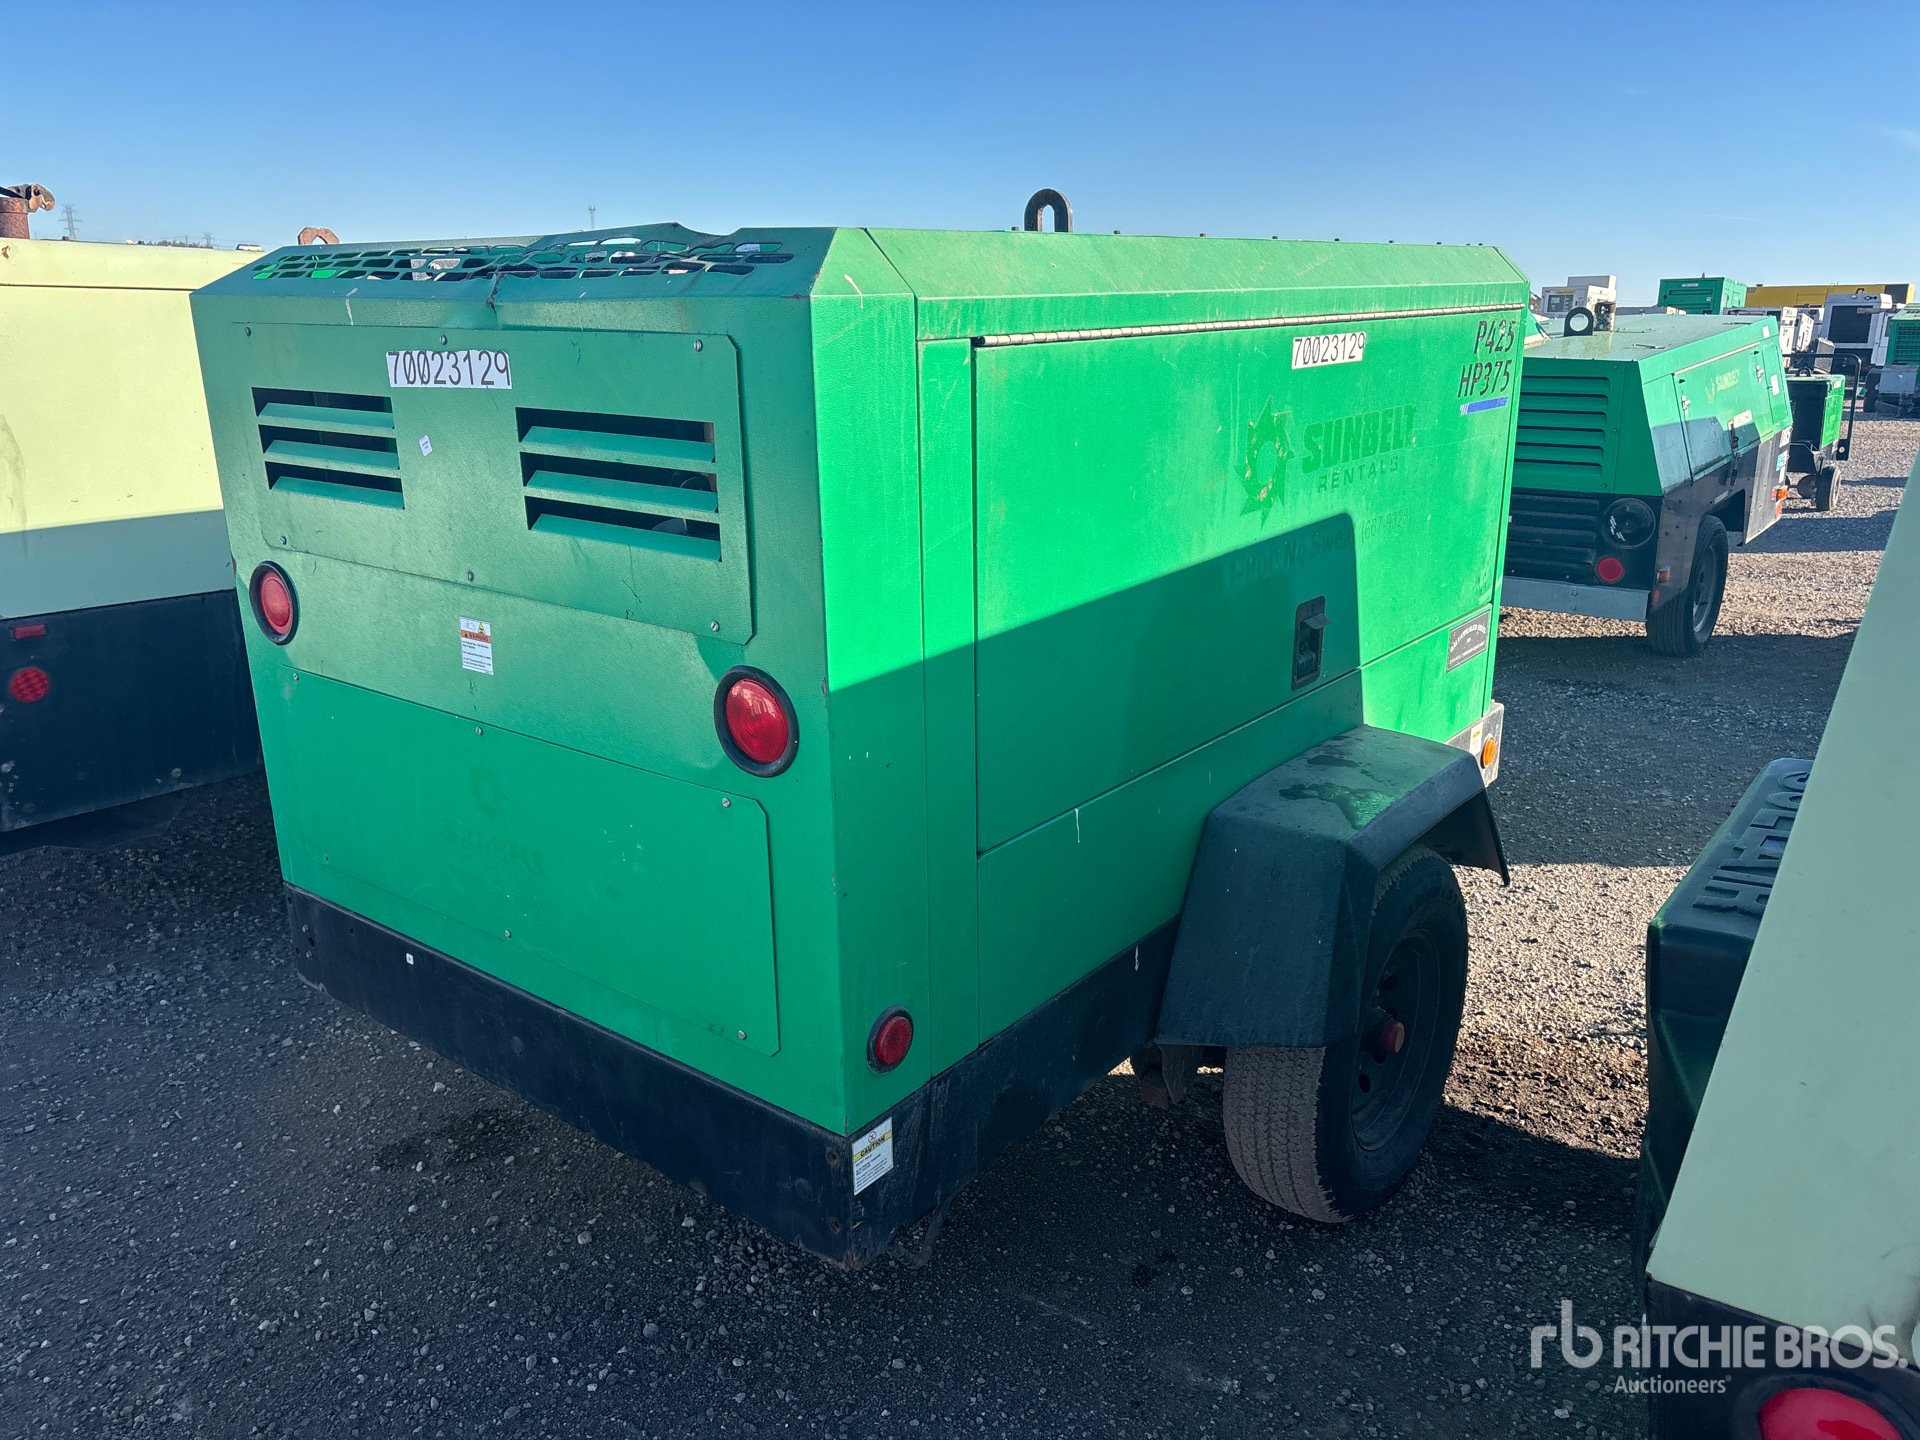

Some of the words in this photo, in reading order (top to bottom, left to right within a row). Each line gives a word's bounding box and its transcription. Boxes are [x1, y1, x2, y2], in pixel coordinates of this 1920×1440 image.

[1294, 332, 1366, 366] 70023129
[1473, 320, 1516, 354] P425
[388, 350, 511, 386] 70023129
[1457, 359, 1512, 398] HP375
[1302, 404, 1416, 474] SUNBELT
[1317, 456, 1398, 493] RENTALS
